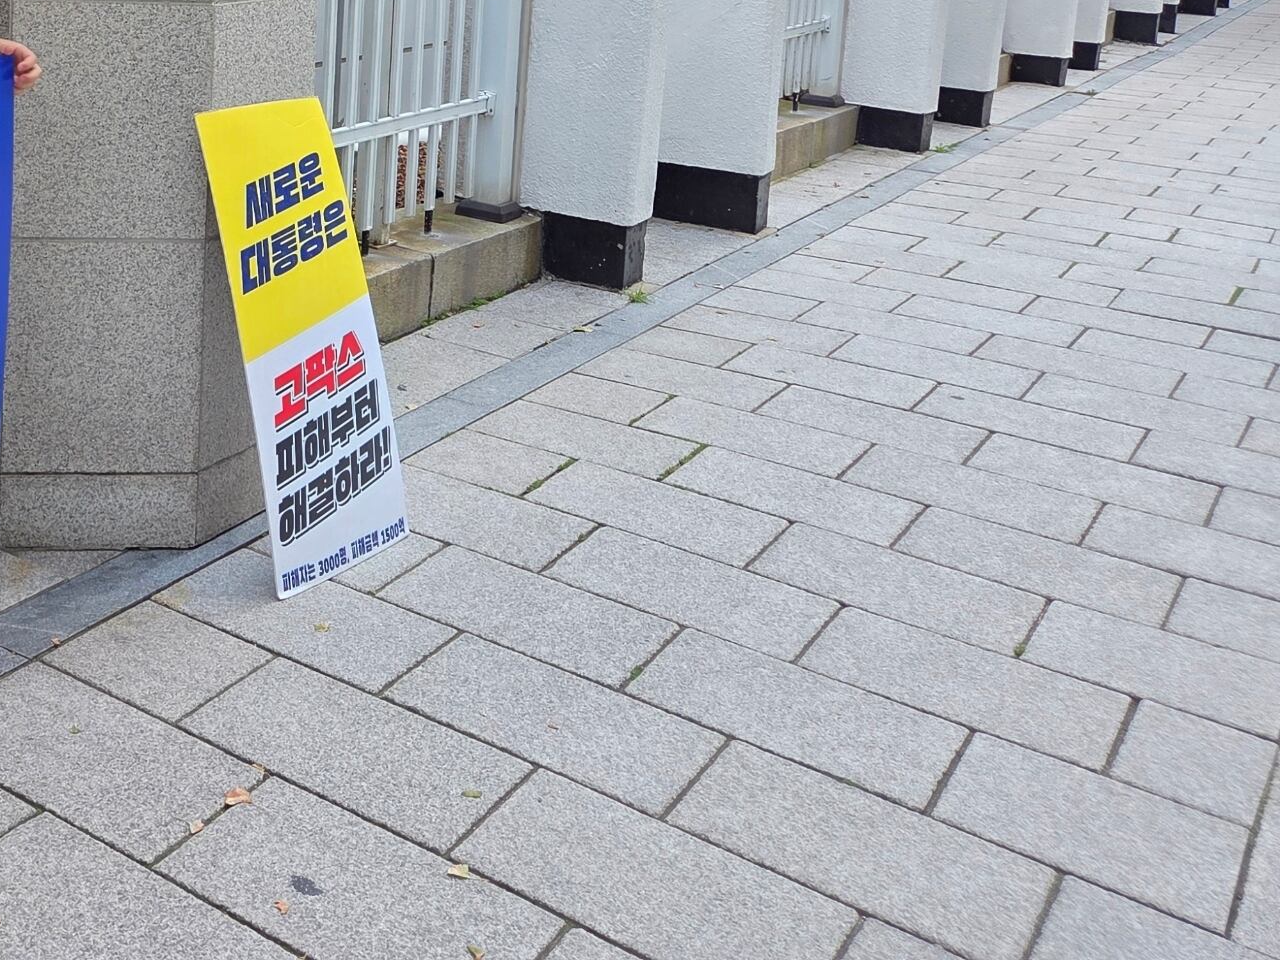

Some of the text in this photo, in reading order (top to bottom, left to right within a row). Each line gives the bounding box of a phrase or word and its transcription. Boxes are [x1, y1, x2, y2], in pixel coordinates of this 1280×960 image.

[245, 152, 325, 229] 새로운
[240, 199, 348, 295] 대통령은
[274, 329, 366, 432] 고팍스
[276, 378, 380, 490] 피해부터
[278, 426, 392, 547] 해결하라!
[281, 516, 406, 592] 피해자는 3000명, 피해금액 1500억
